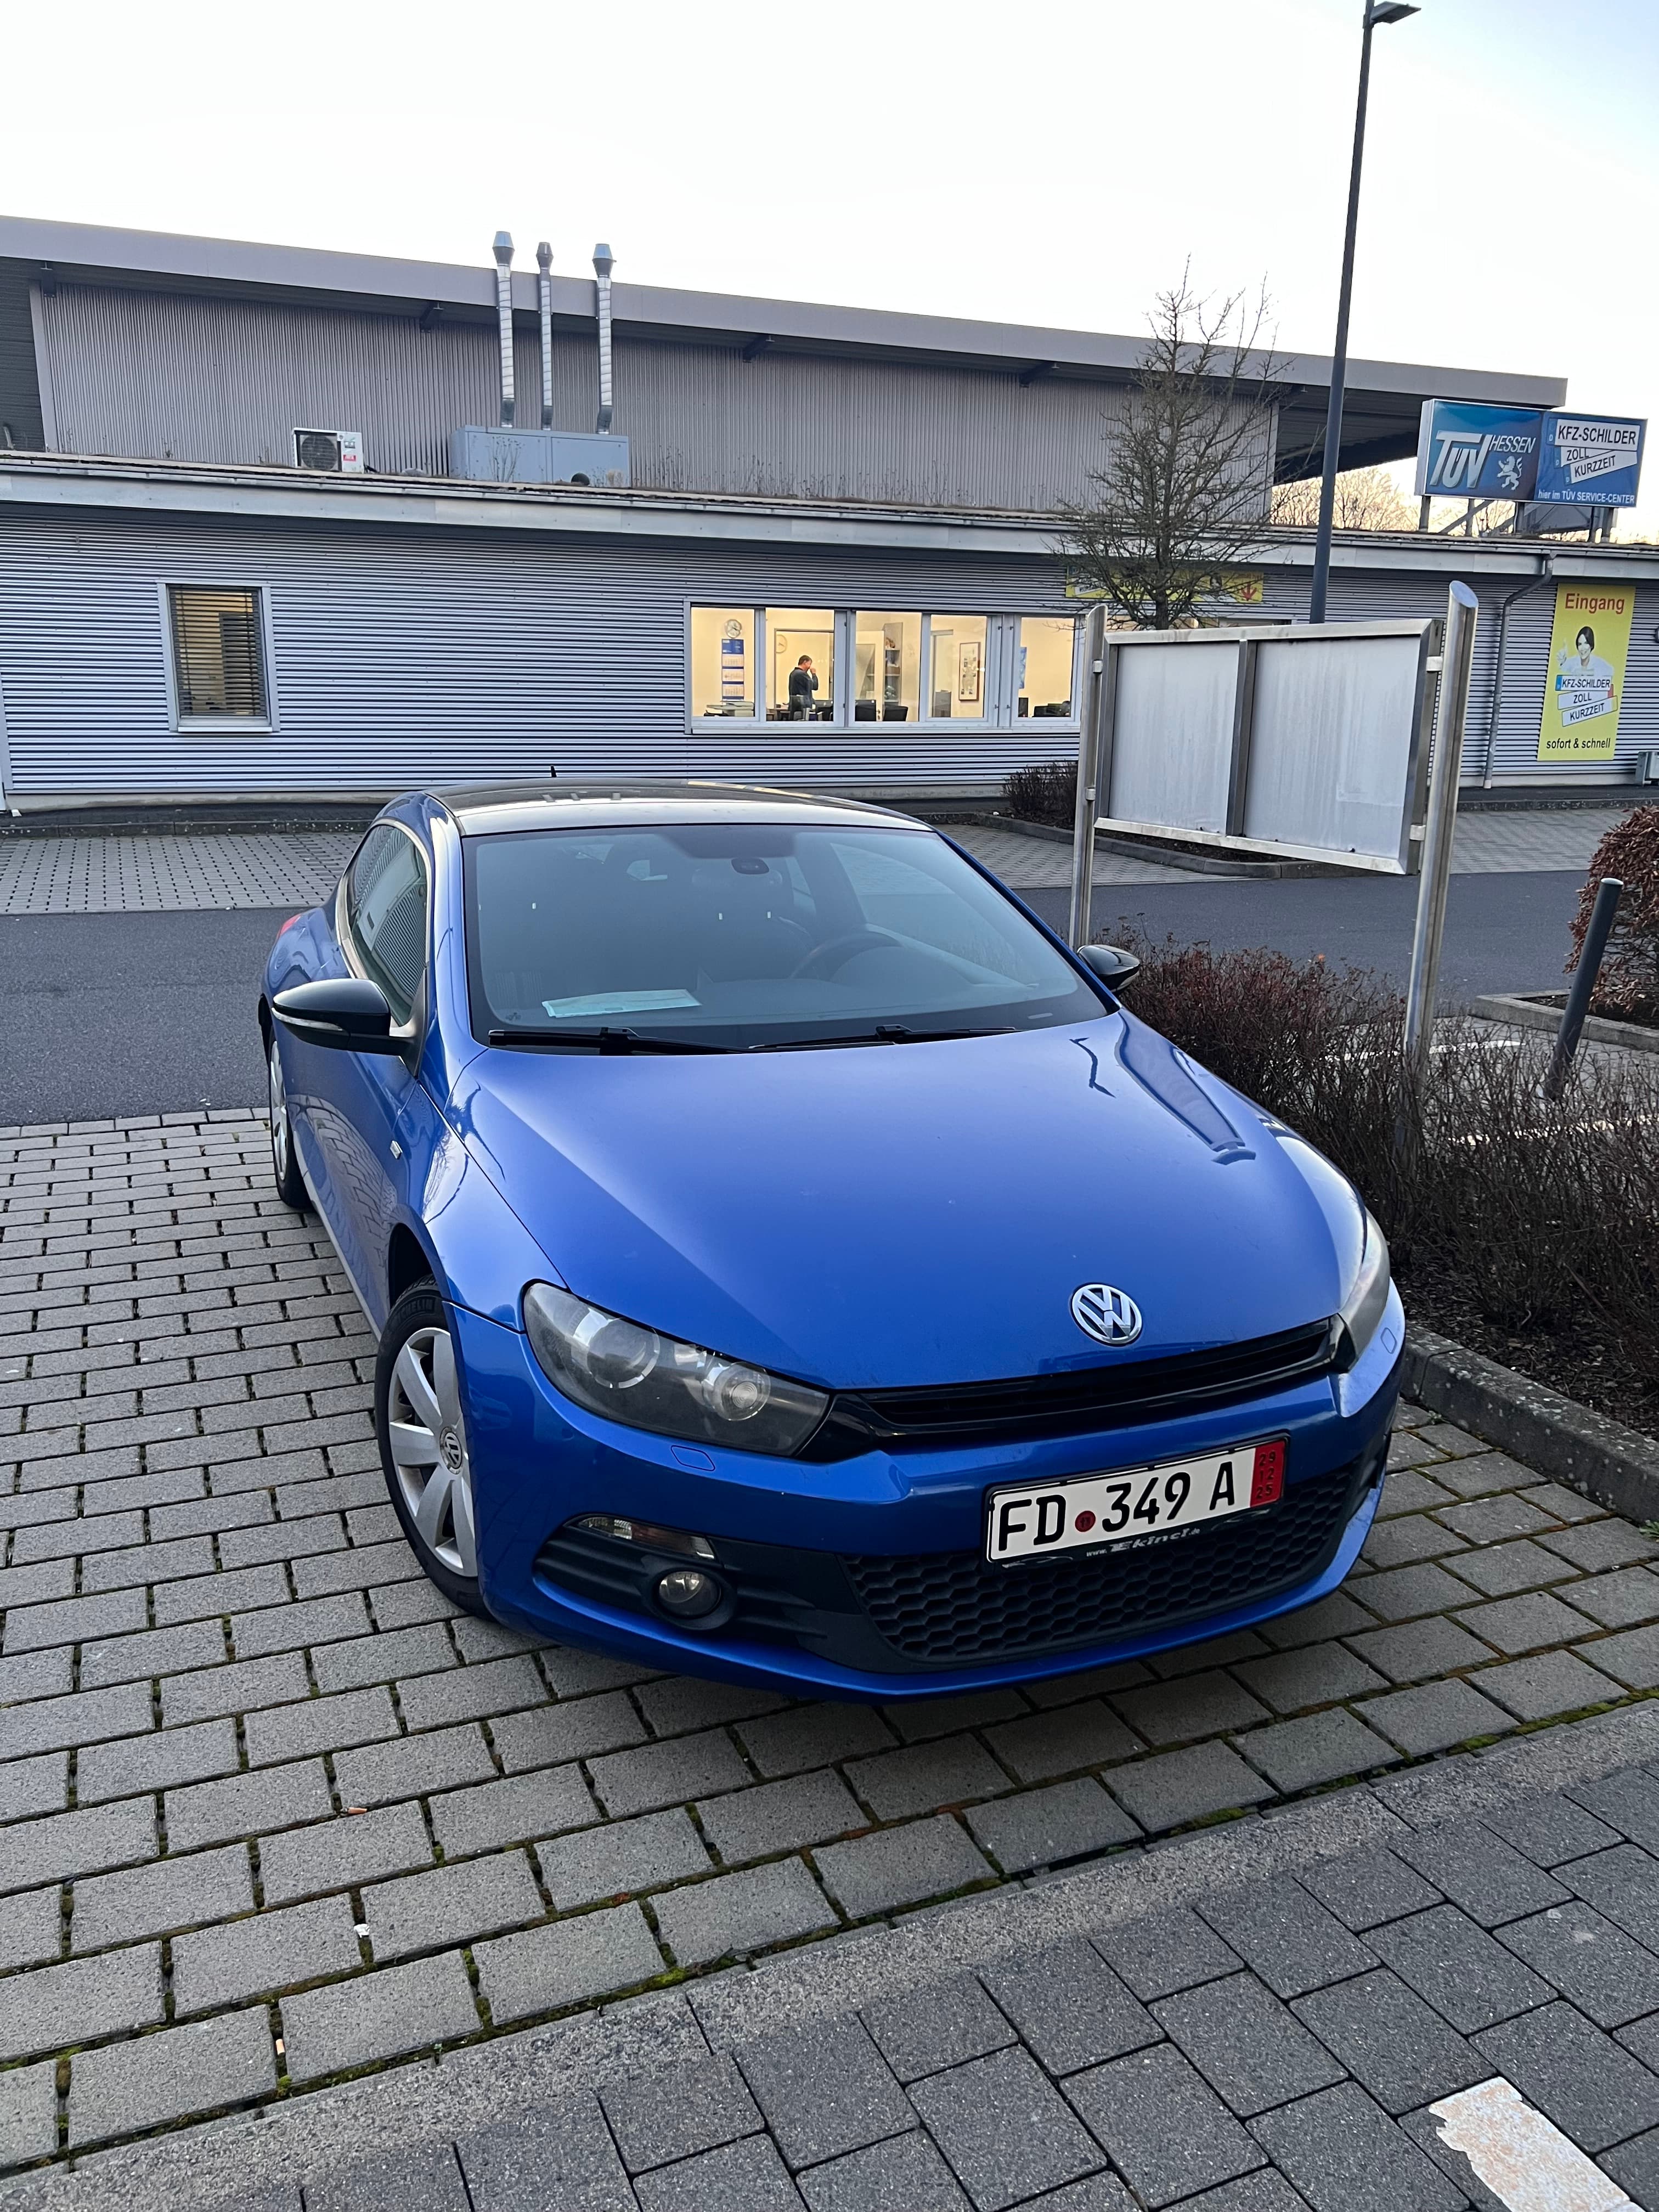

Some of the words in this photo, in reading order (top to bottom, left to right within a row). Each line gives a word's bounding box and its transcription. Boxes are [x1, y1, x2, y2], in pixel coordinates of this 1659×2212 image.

[1558, 425, 1637, 445] KFZ-SCHILDER
[1488, 435, 1536, 454] HESSEN
[1429, 430, 1493, 489] TÜV
[1566, 448, 1590, 461] ZOLL
[1575, 455, 1616, 478] KURZZEIT
[1538, 489, 1551, 499] hier
[1552, 490, 1560, 500] im
[1562, 489, 1576, 501] TÜV
[1577, 490, 1635, 504] SERVICE-CENTER
[1565, 592, 1625, 615] Eingang
[1561, 679, 1611, 688] KFZ-SCHILDER
[1573, 692, 1592, 704] ZOLL
[1570, 702, 1605, 721] KURZZEIT
[1546, 738, 1571, 749] sofort
[1573, 738, 1579, 748] &
[1581, 738, 1611, 749] schnell
[1259, 1450, 1276, 1466] 29
[1259, 1466, 1275, 1483] 12
[1256, 1482, 1273, 1499] 25
[998, 1494, 1066, 1551] FD
[1102, 1472, 1191, 1532] 349
[1209, 1461, 1235, 1511] A
